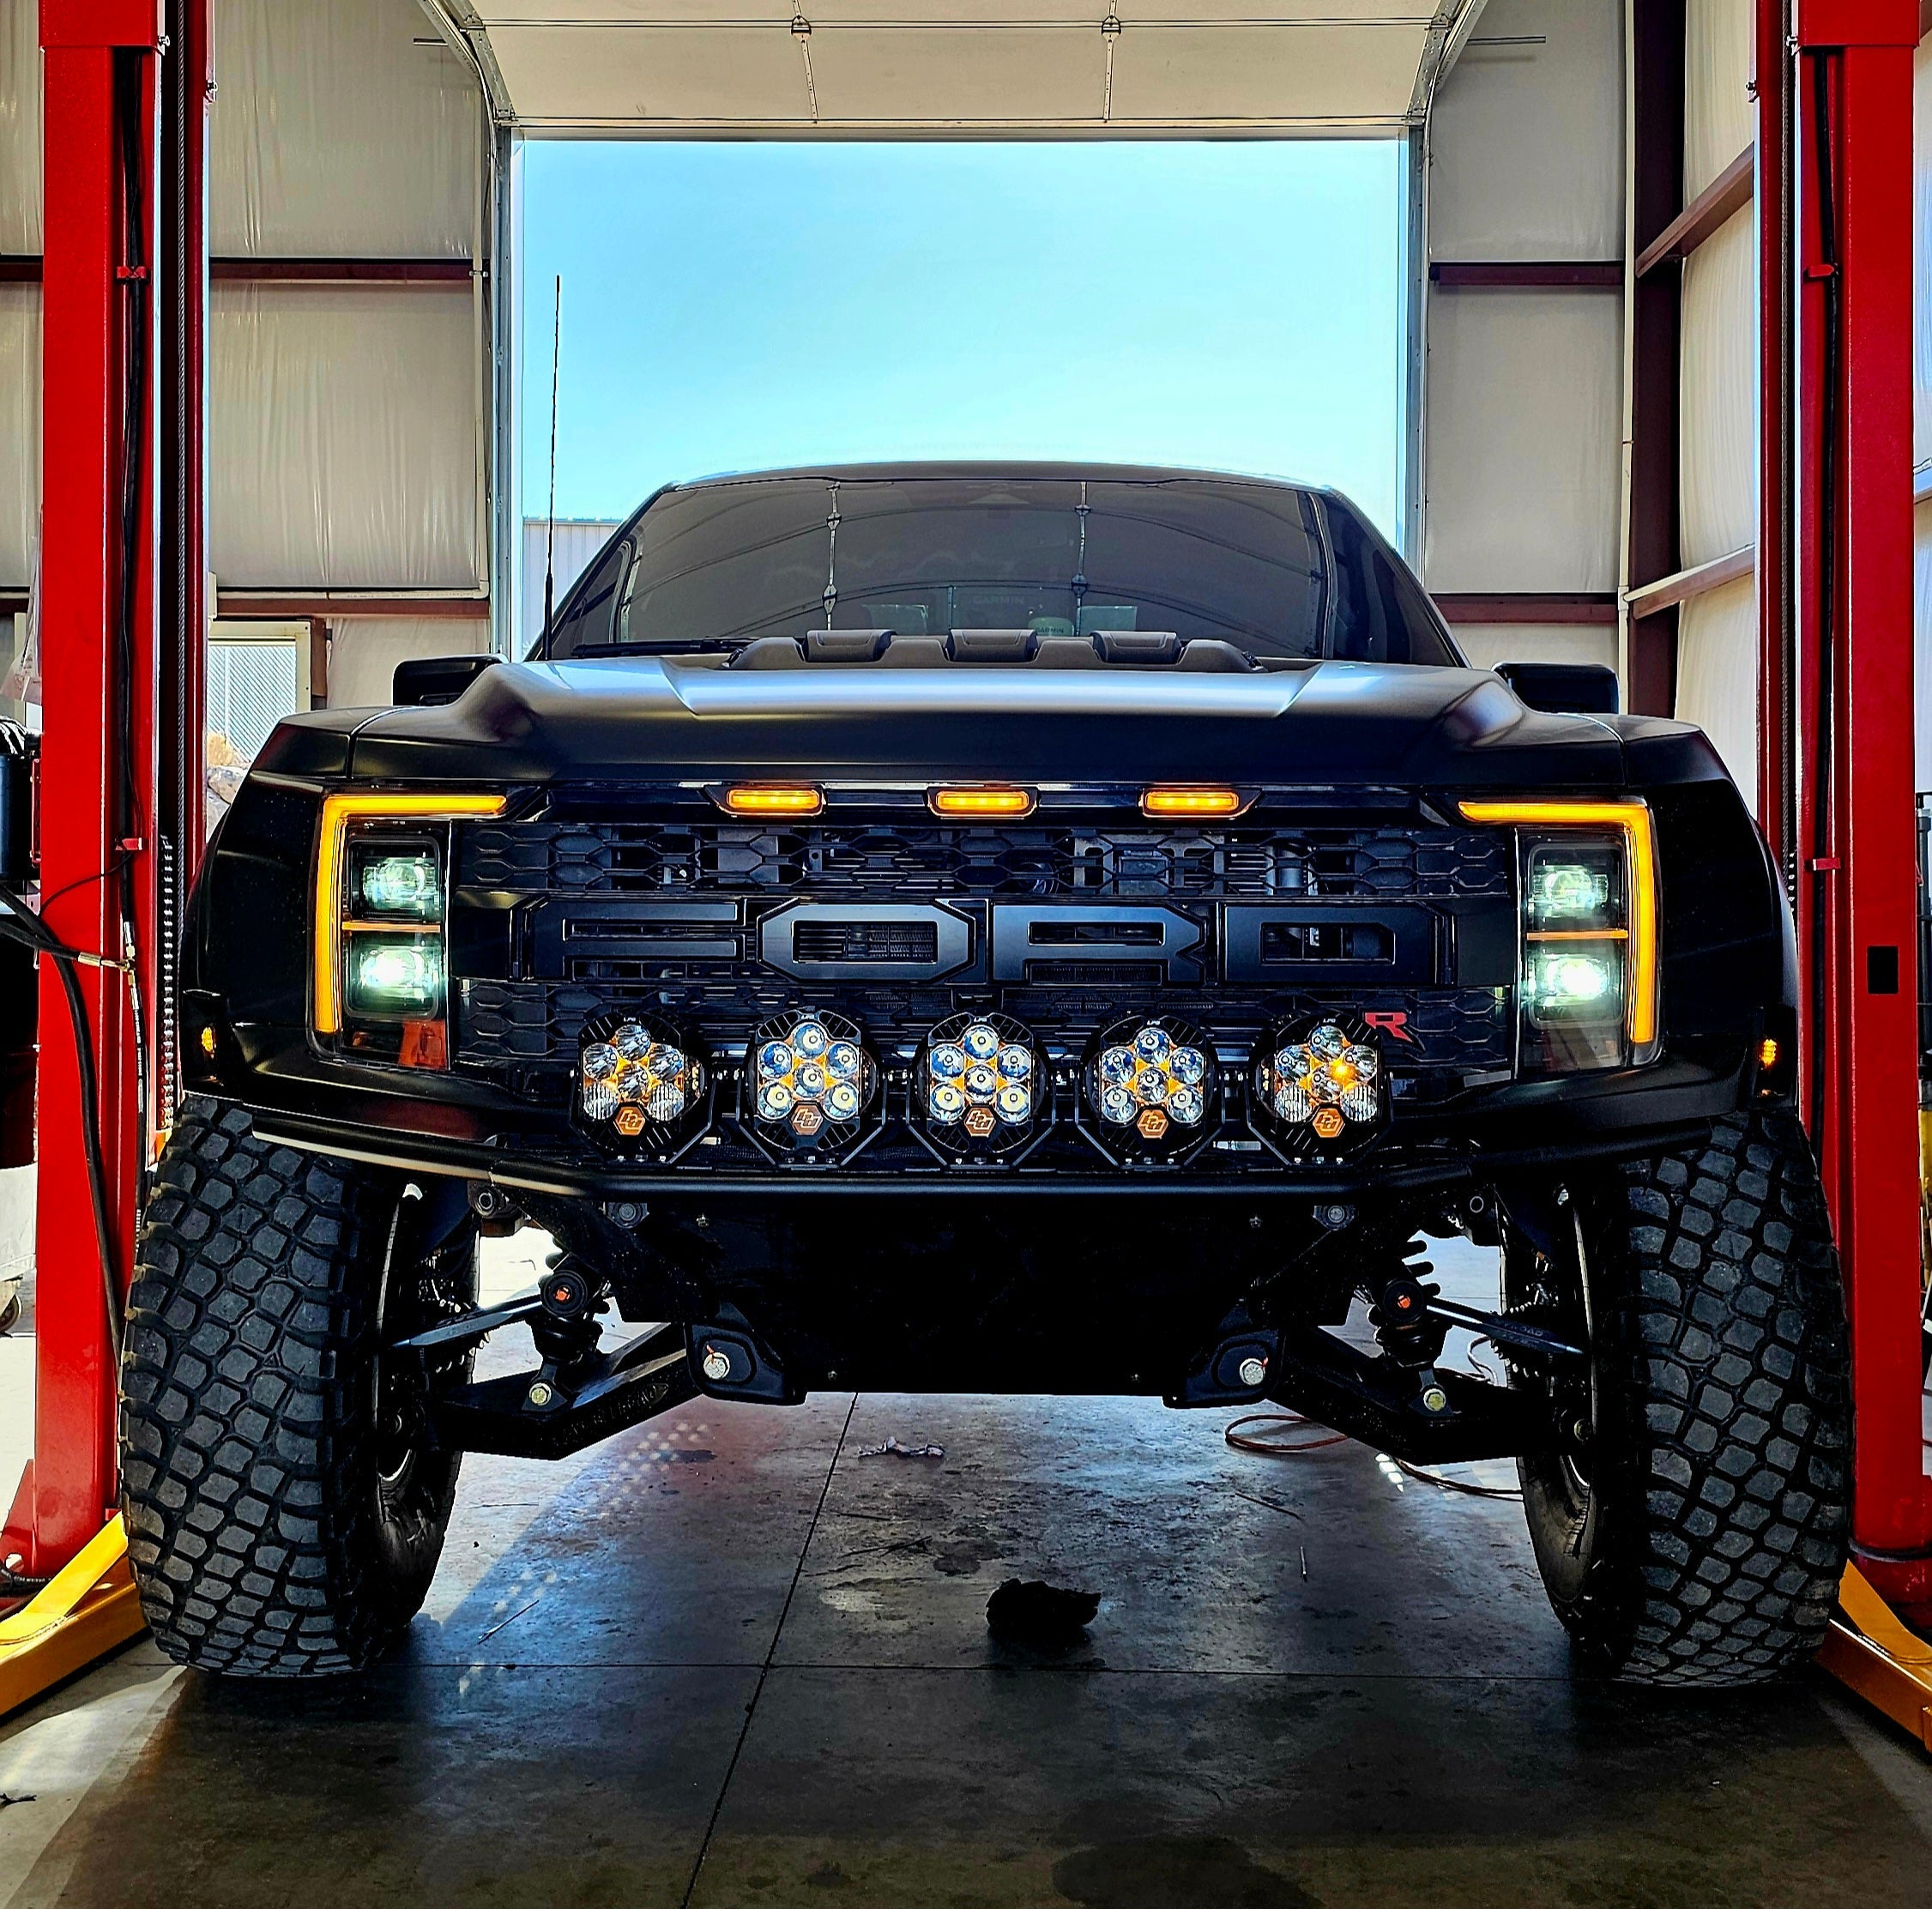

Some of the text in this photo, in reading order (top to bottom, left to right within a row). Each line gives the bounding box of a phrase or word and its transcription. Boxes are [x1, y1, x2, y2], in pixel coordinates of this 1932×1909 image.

[973, 596, 1025, 605] GARMIN
[530, 901, 1439, 984] FORD
[1364, 1012, 1415, 1043] R
